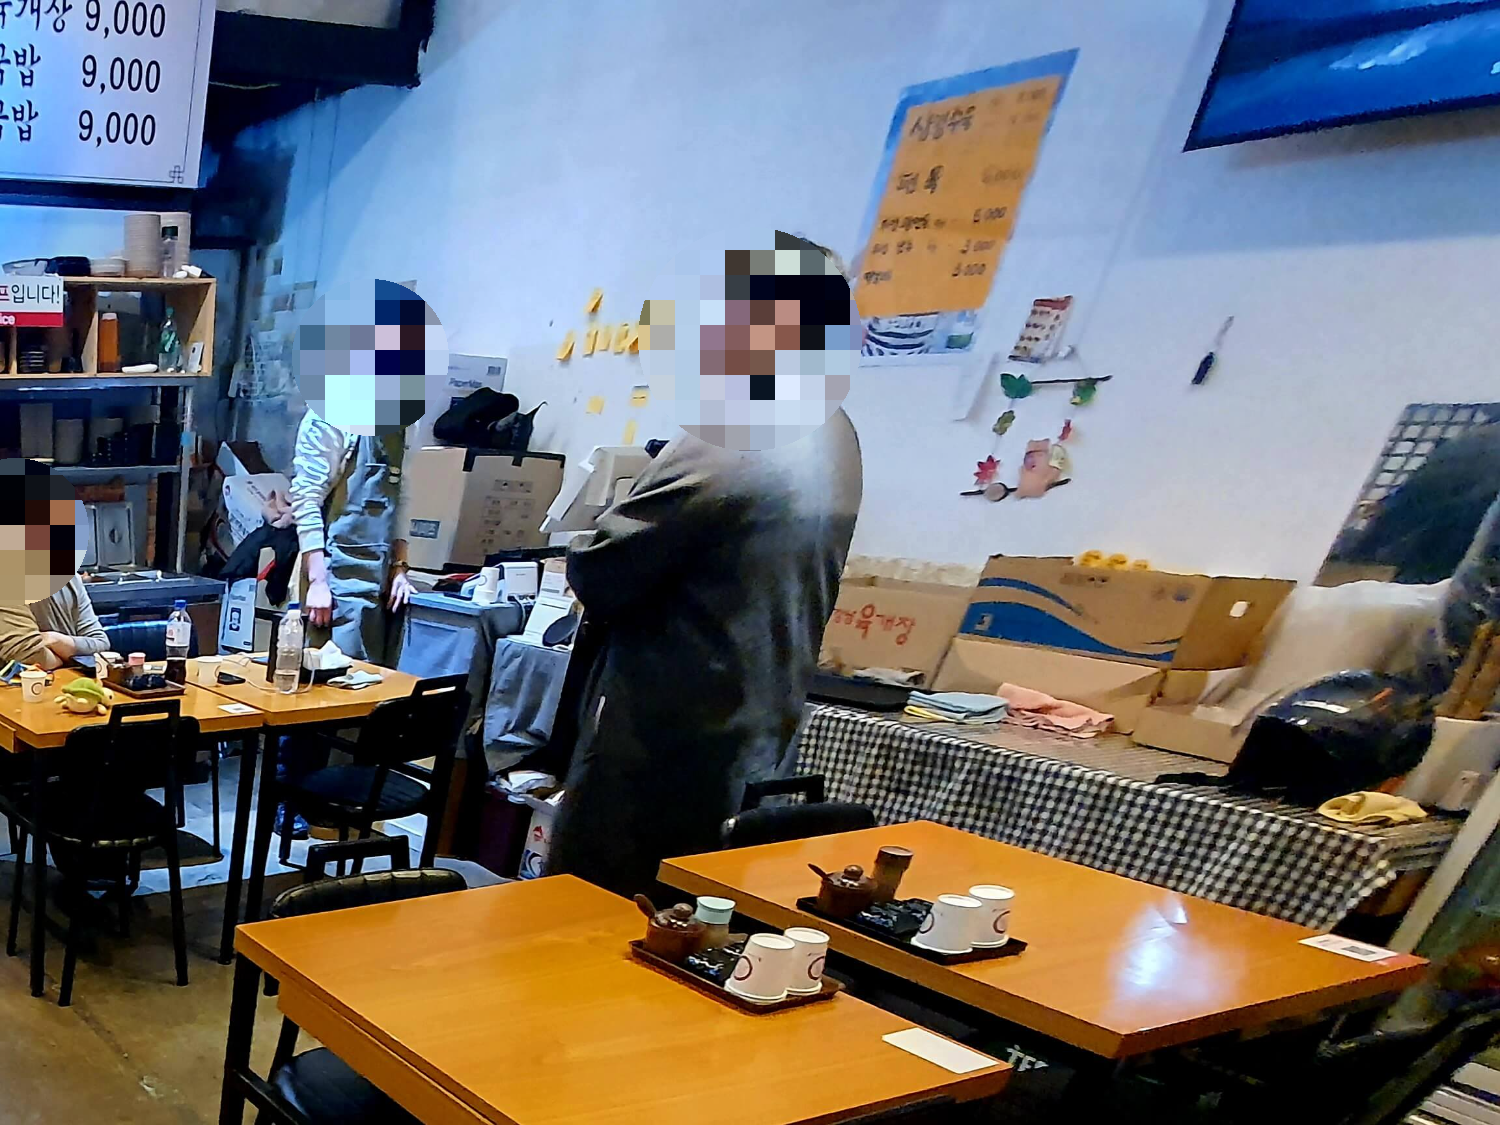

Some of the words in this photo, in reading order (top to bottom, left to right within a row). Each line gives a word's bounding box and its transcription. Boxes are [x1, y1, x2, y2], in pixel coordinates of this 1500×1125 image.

[85, 0, 166, 39] 9,000
[82, 55, 161, 94] 9,000
[78, 110, 156, 147] 9,000
